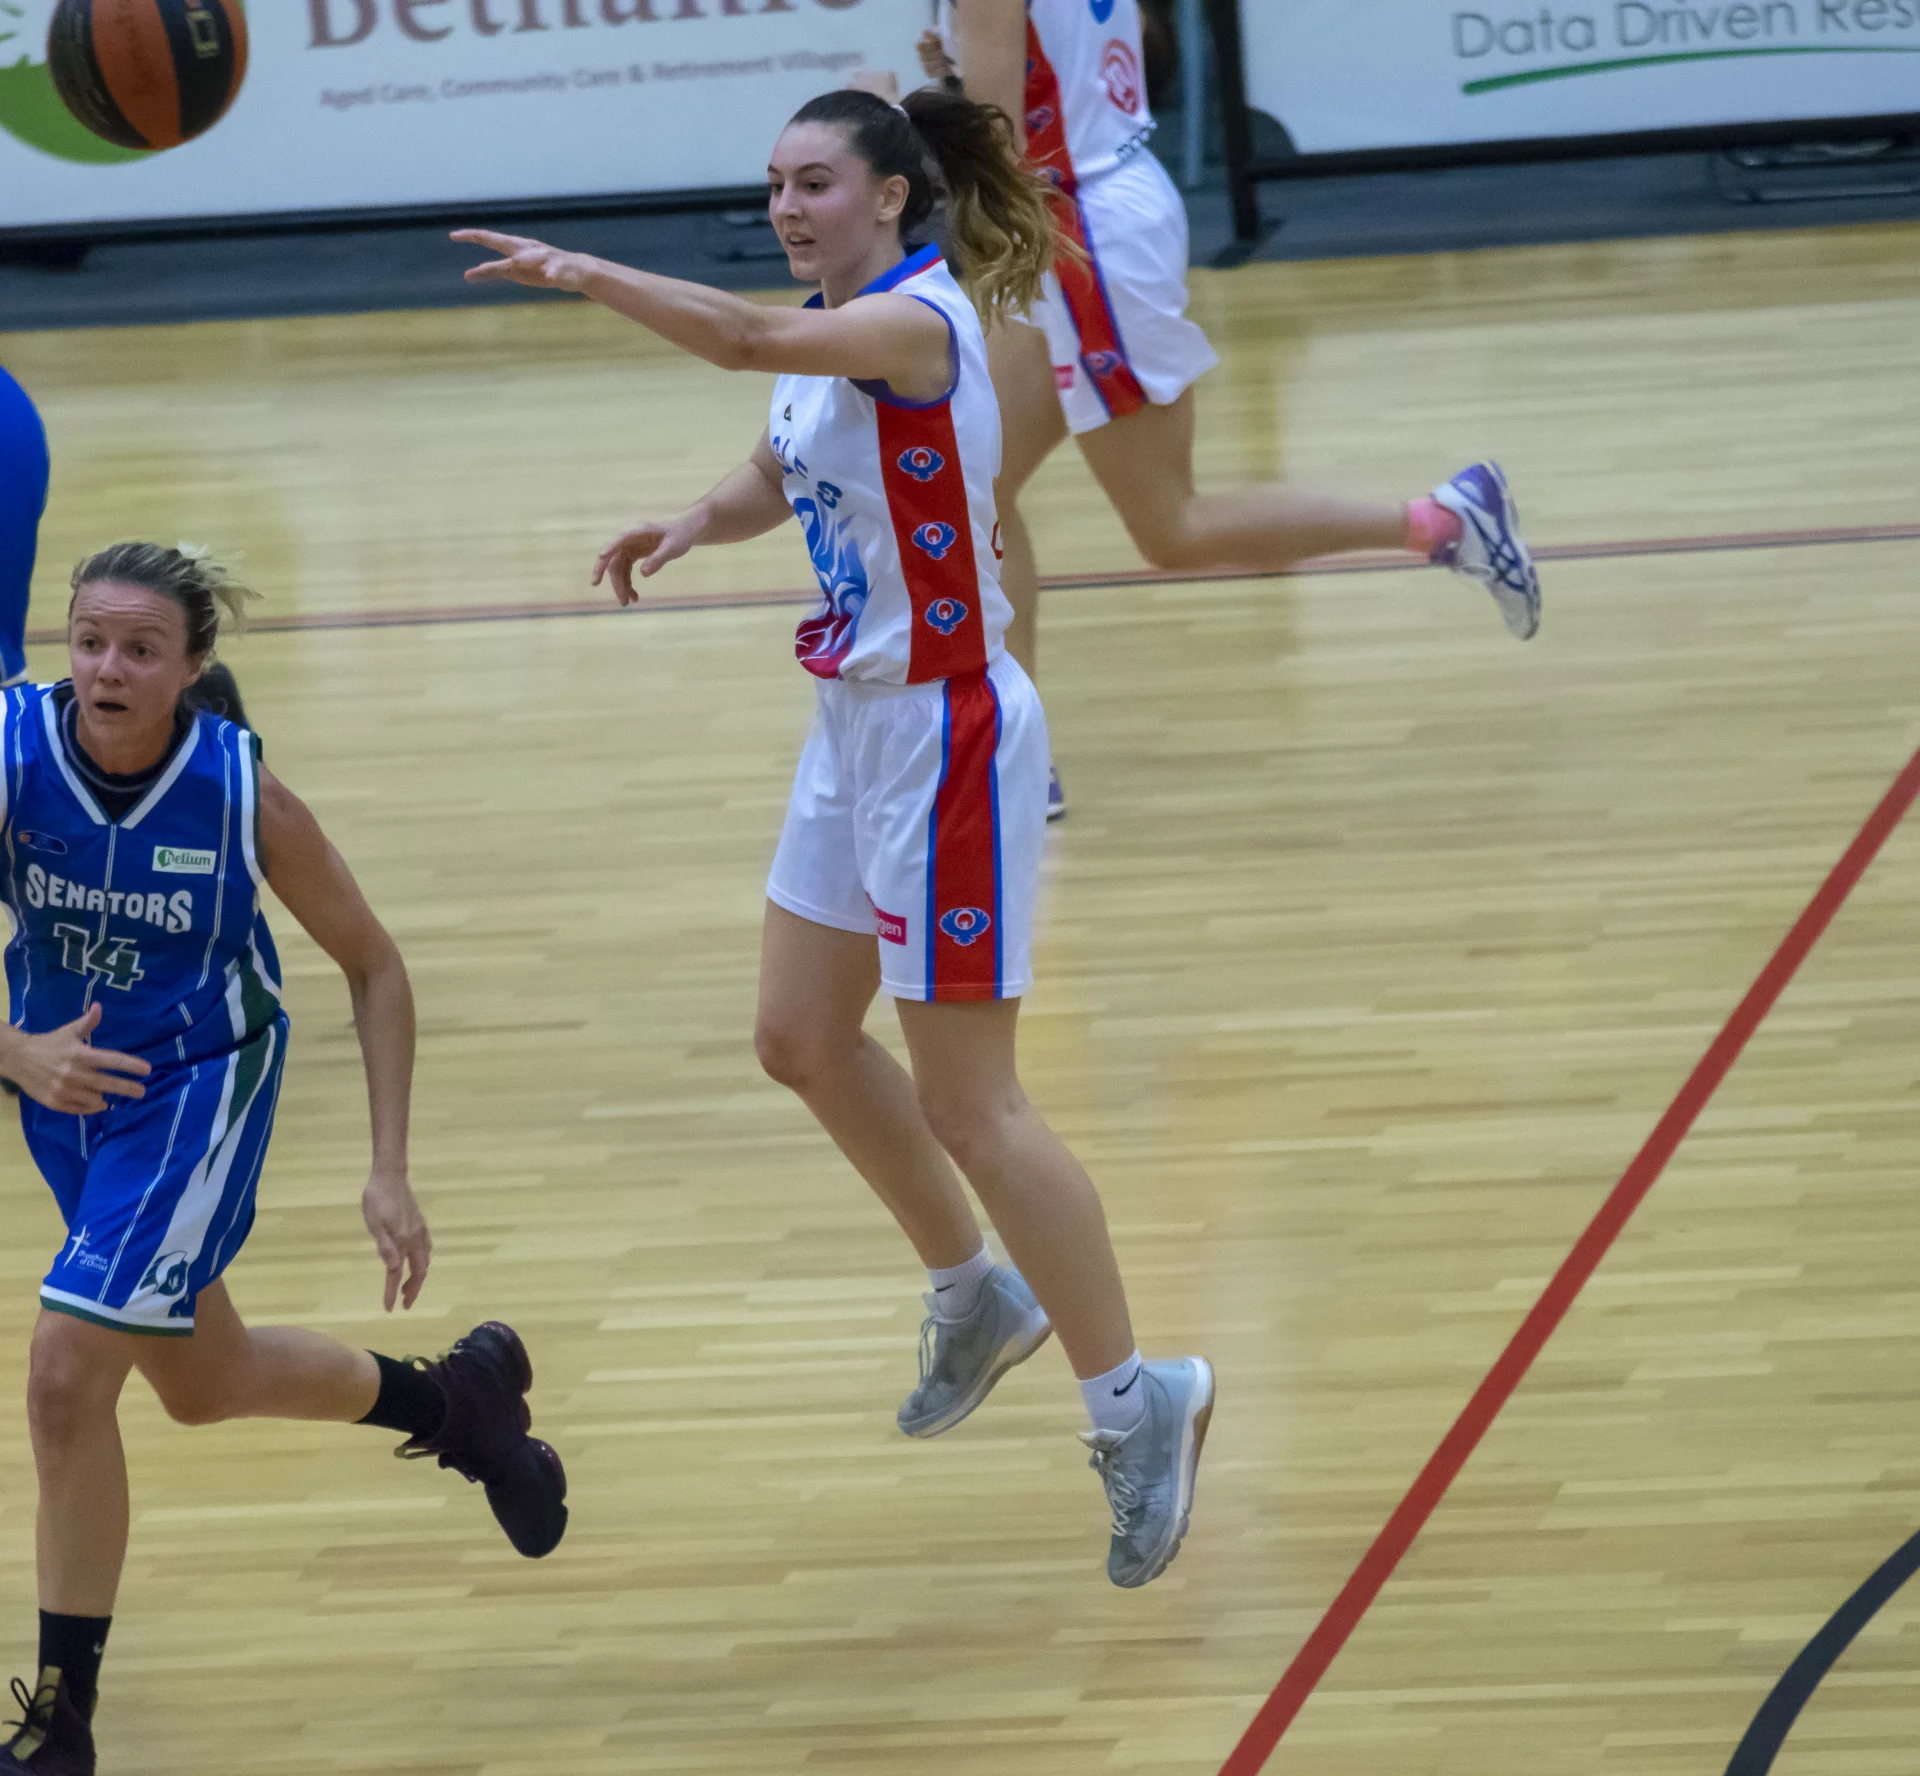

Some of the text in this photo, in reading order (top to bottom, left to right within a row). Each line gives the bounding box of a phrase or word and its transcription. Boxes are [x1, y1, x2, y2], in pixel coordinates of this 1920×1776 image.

[1450, 0, 1920, 58] Data Driven Res
[320, 87, 374, 111] Aged
[440, 73, 566, 99] Community
[571, 68, 621, 88] Care
[628, 63, 644, 83] &
[652, 56, 774, 82] Retirement
[779, 52, 863, 74] Villages
[26, 863, 193, 934] SENATORS
[876, 918, 902, 936] gen
[53, 922, 145, 992] 14
